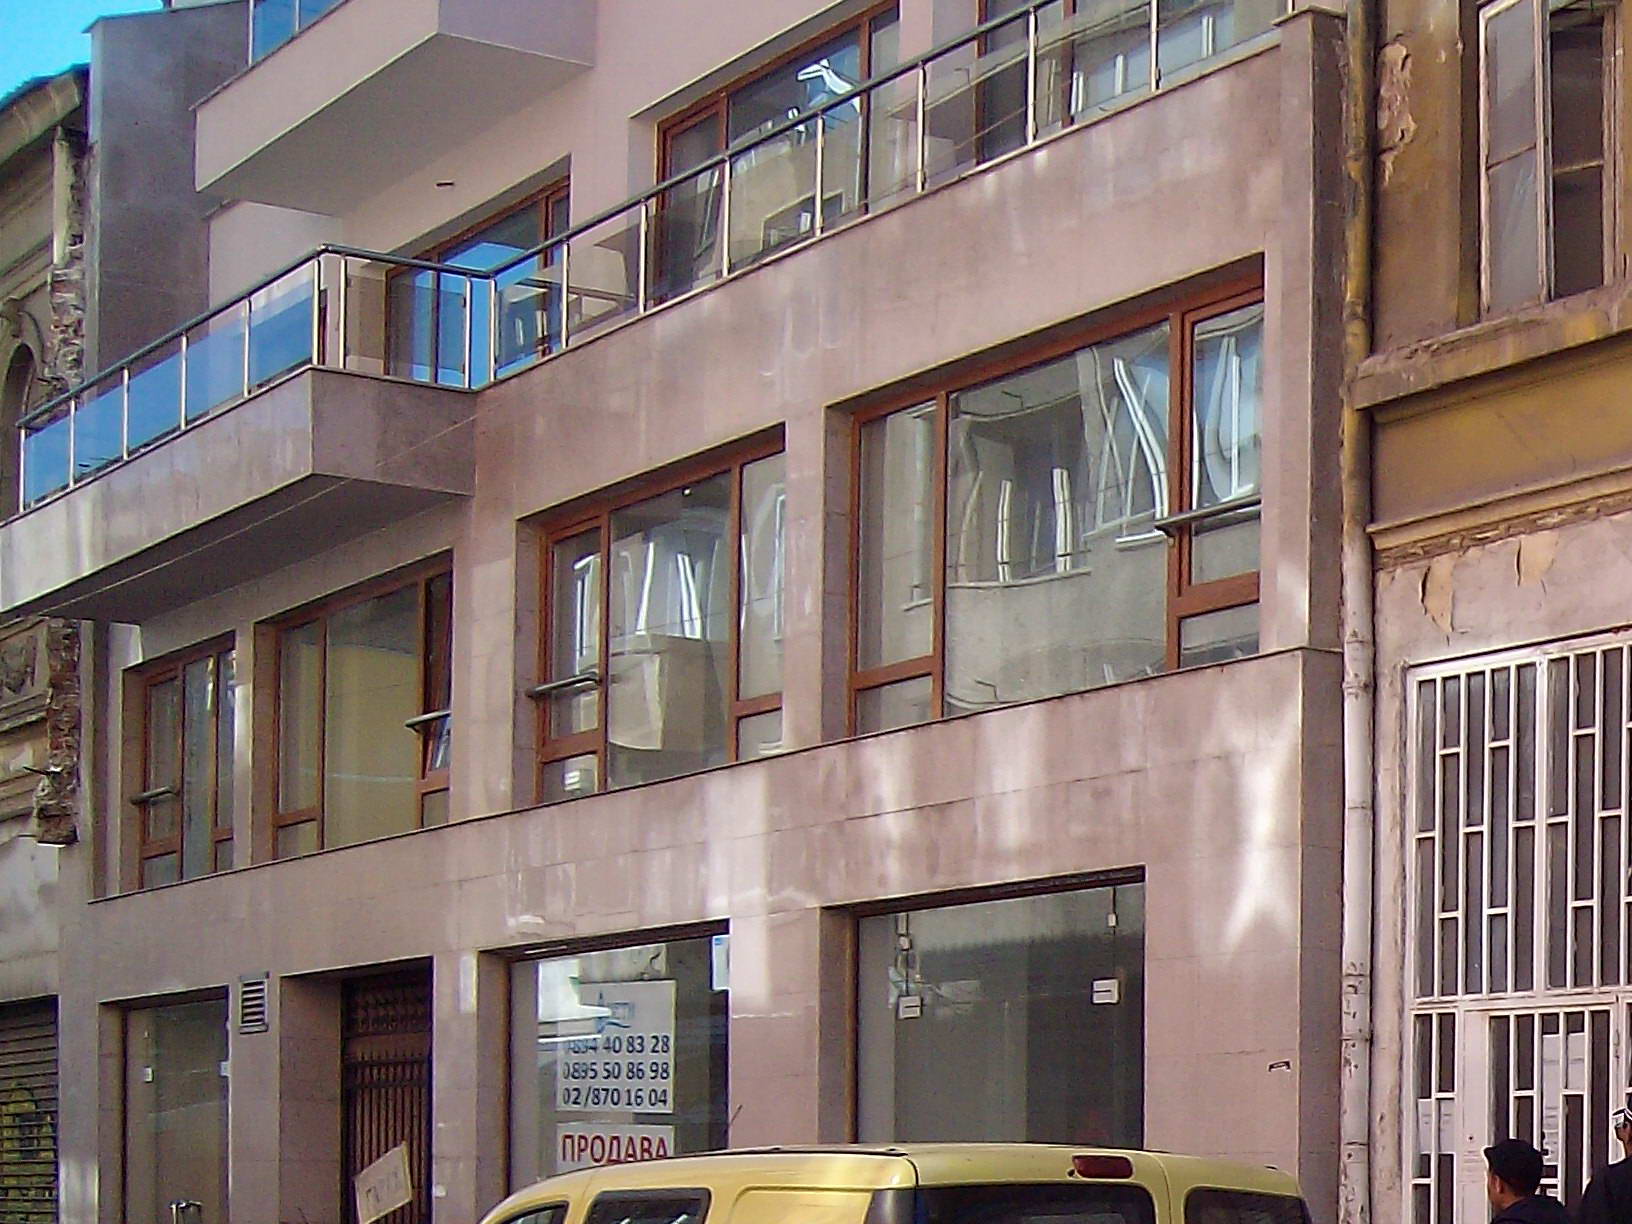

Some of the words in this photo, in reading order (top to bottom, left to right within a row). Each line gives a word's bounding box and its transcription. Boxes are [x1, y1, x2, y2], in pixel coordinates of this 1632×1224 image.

[602, 1036, 622, 1054] 40
[626, 1035, 645, 1054] 83
[650, 1034, 670, 1053] 28
[602, 1061, 622, 1079] 50
[626, 1061, 645, 1080] 86
[649, 1061, 670, 1080] 98
[625, 1088, 644, 1107] 16
[649, 1088, 668, 1107] 04
[562, 1134, 669, 1164] ПРОДАВА
